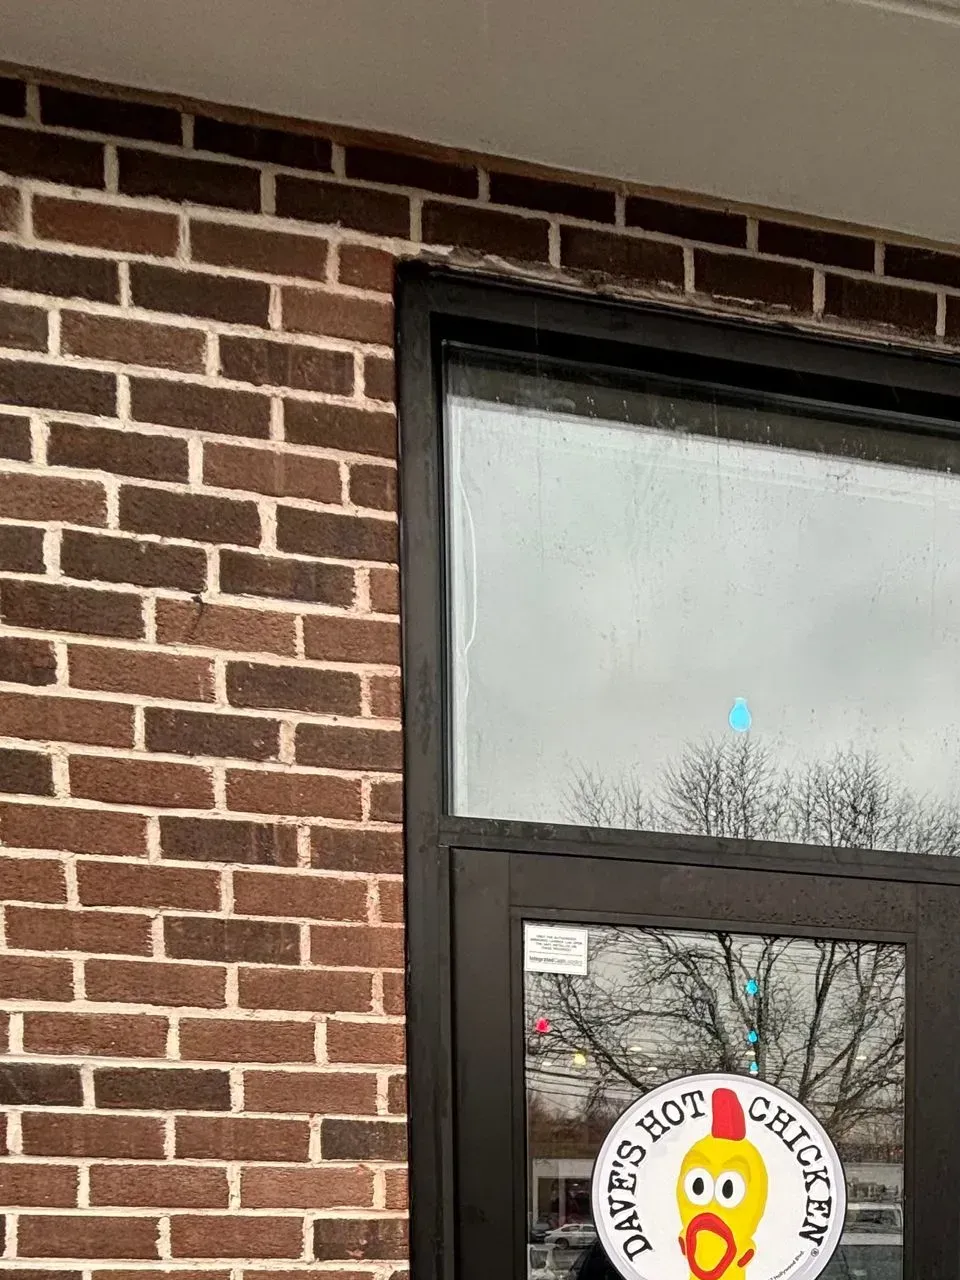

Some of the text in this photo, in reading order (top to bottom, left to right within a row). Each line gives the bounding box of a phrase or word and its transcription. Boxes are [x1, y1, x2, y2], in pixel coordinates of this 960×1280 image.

[607, 1090, 833, 1262] DAVE'S HOT CHICKEN
[774, 1261, 796, 1280] Hollywood
